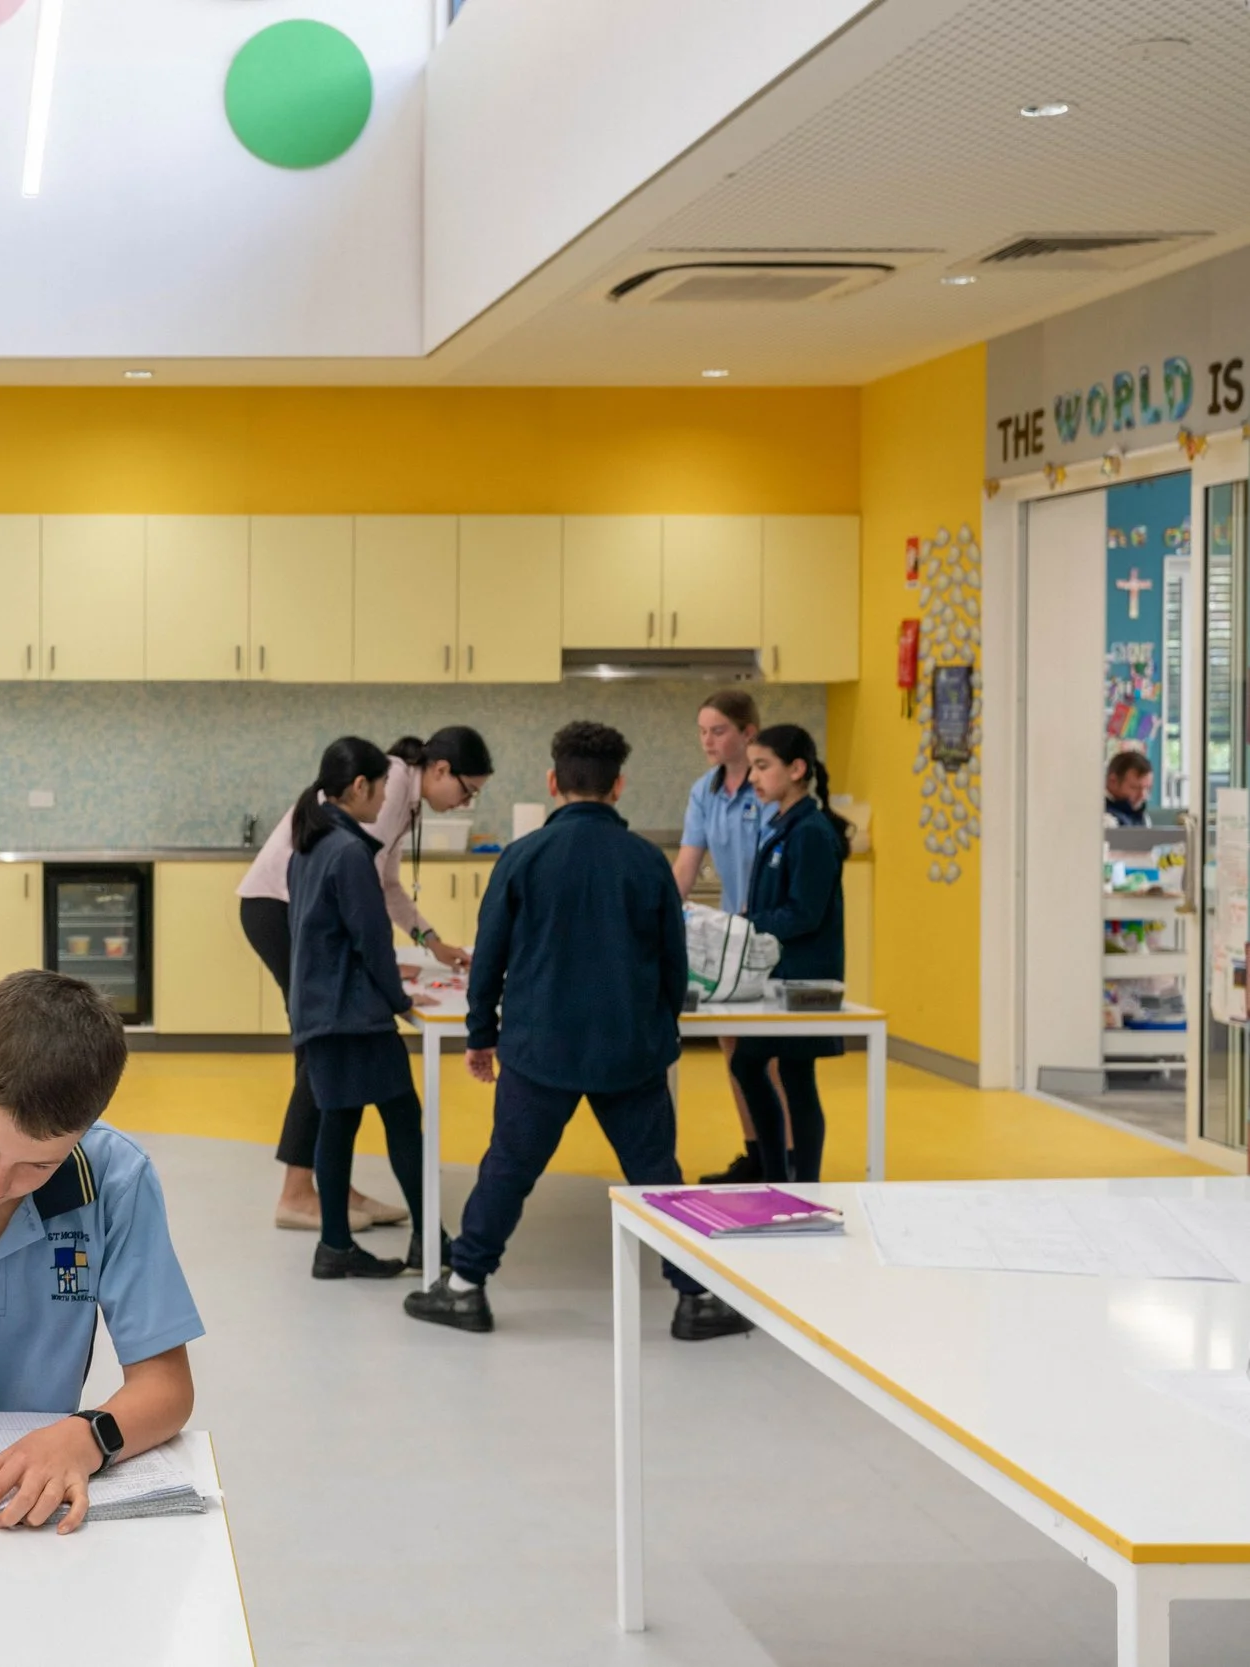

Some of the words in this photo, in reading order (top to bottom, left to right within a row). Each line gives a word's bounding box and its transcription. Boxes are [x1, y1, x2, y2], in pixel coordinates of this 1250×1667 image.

[997, 407, 1045, 463] THE
[1054, 355, 1193, 443] WORLD
[1207, 357, 1244, 416] IS
[47, 1232, 60, 1242] ST
